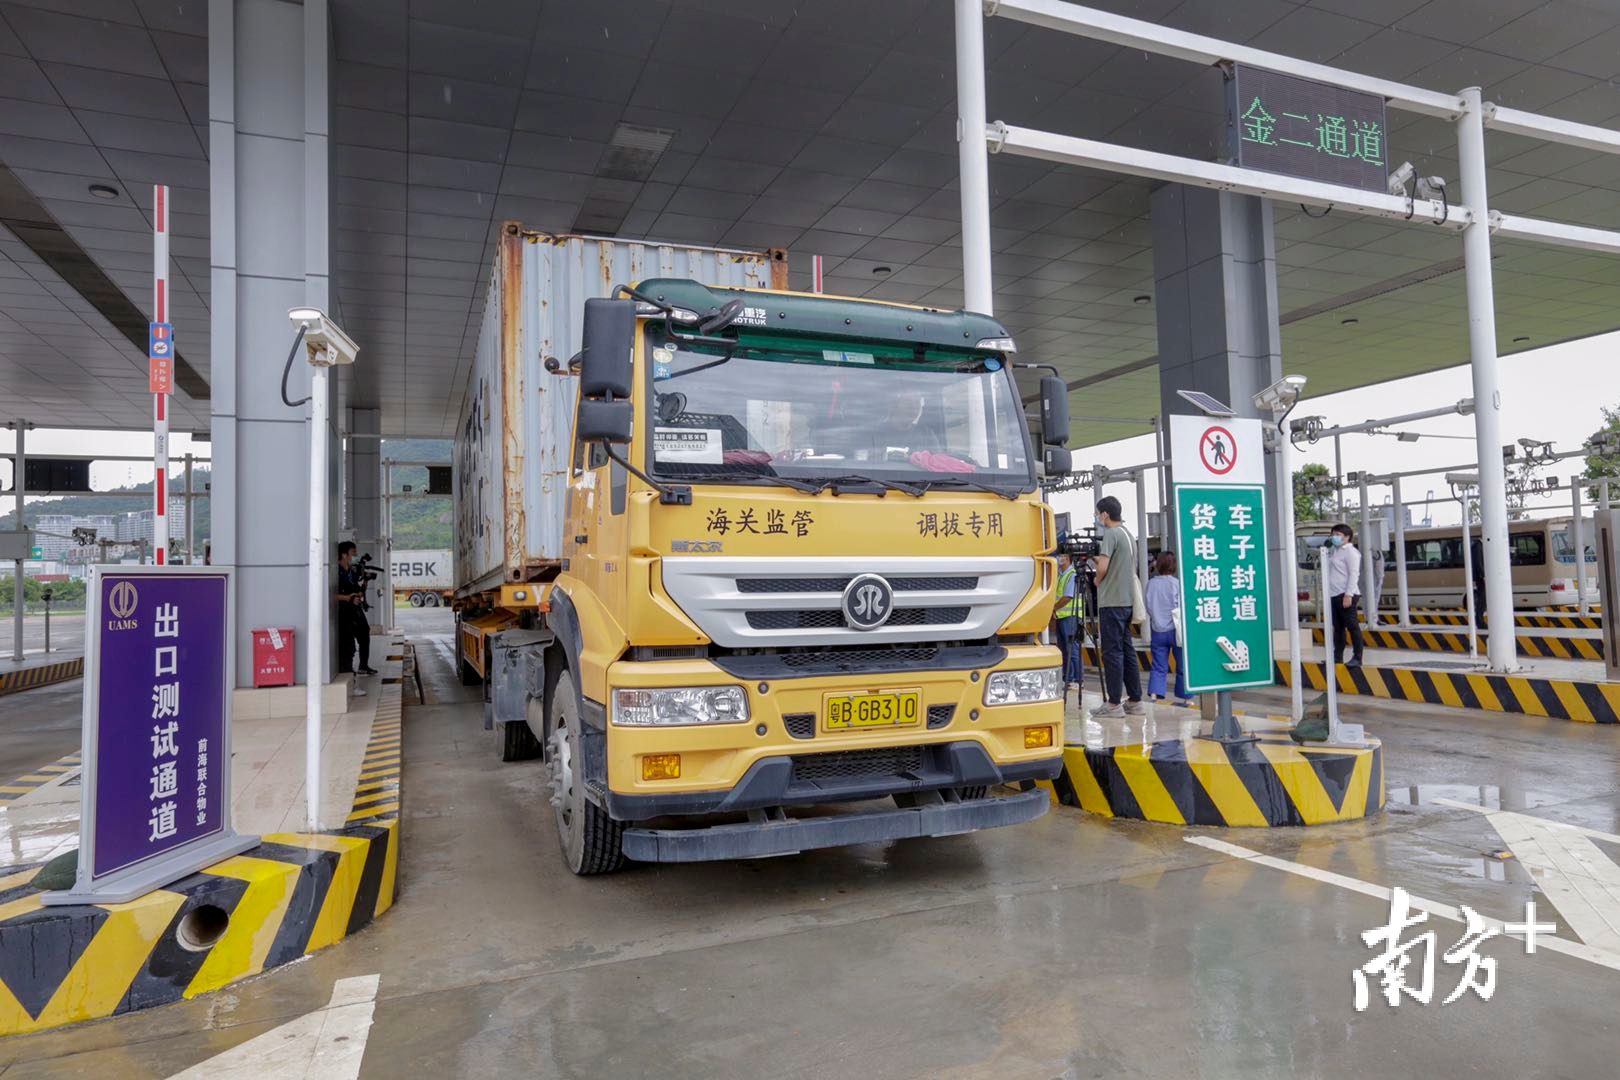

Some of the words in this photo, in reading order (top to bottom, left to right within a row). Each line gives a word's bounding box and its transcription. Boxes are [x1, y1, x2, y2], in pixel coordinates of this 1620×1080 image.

[1241, 96, 1384, 167] 金二通道
[706, 507, 815, 537] 海关监管
[1190, 503, 1253, 531] 货车
[1193, 535, 1255, 561] 电子
[391, 562, 437, 577] ERSK
[1194, 564, 1256, 592] 施封
[1195, 596, 1258, 623] 通道
[108, 619, 138, 631] UAMS
[148, 602, 180, 843] 出口测试通道
[196, 737, 209, 827] 前海联合物业
